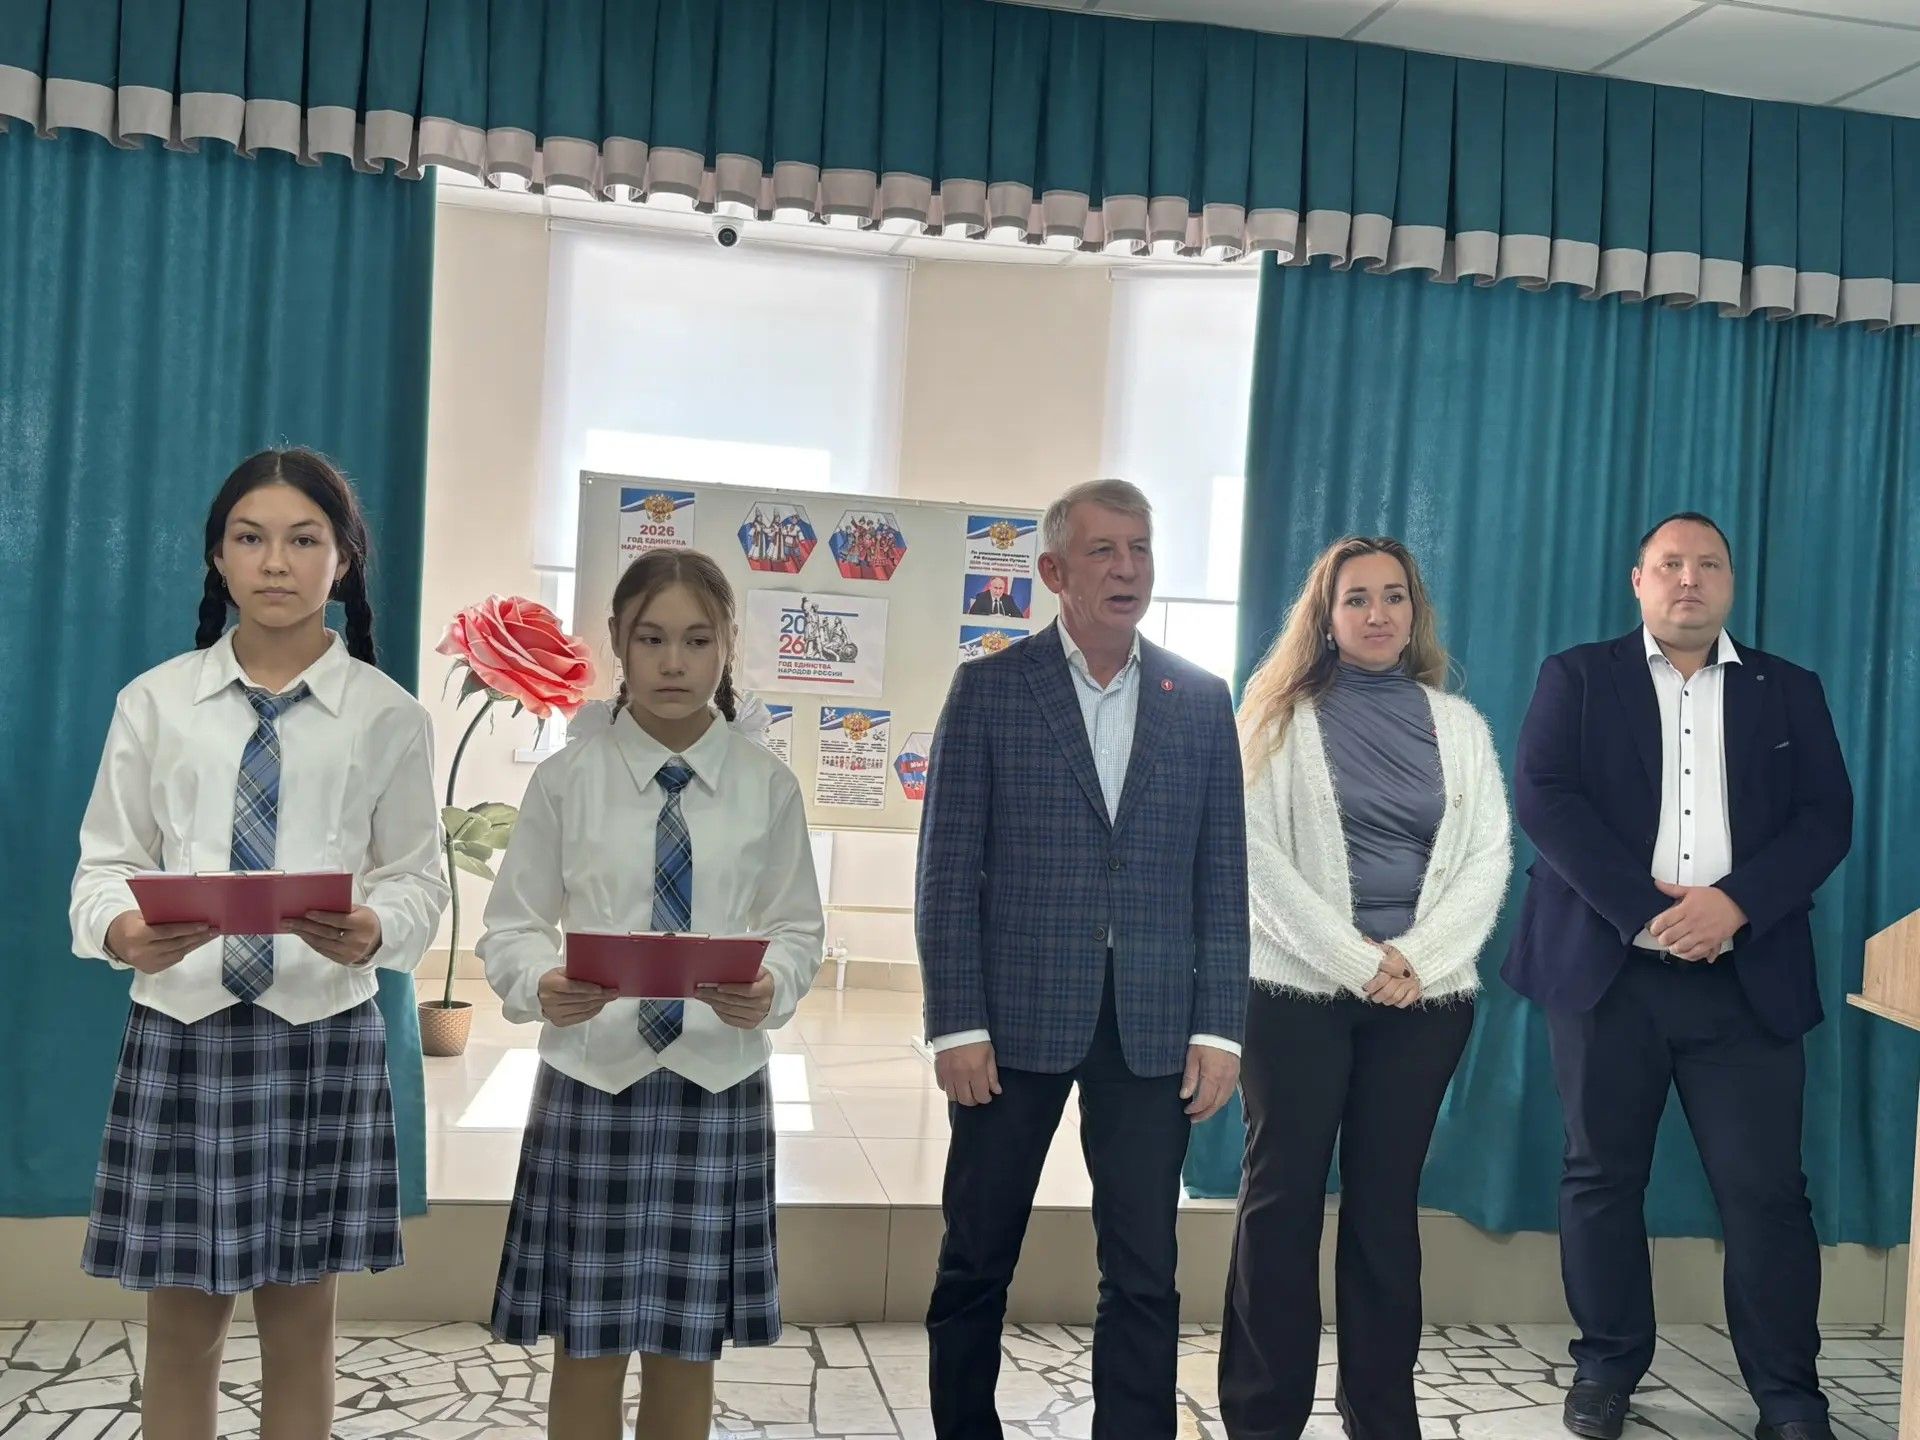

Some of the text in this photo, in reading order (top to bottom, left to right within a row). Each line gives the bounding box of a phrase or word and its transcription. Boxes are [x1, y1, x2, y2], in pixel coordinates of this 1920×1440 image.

[640, 525, 674, 536] 2026
[645, 538, 686, 546] ЕДИНСТВА
[780, 614, 805, 634] 20
[779, 634, 805, 654] 26
